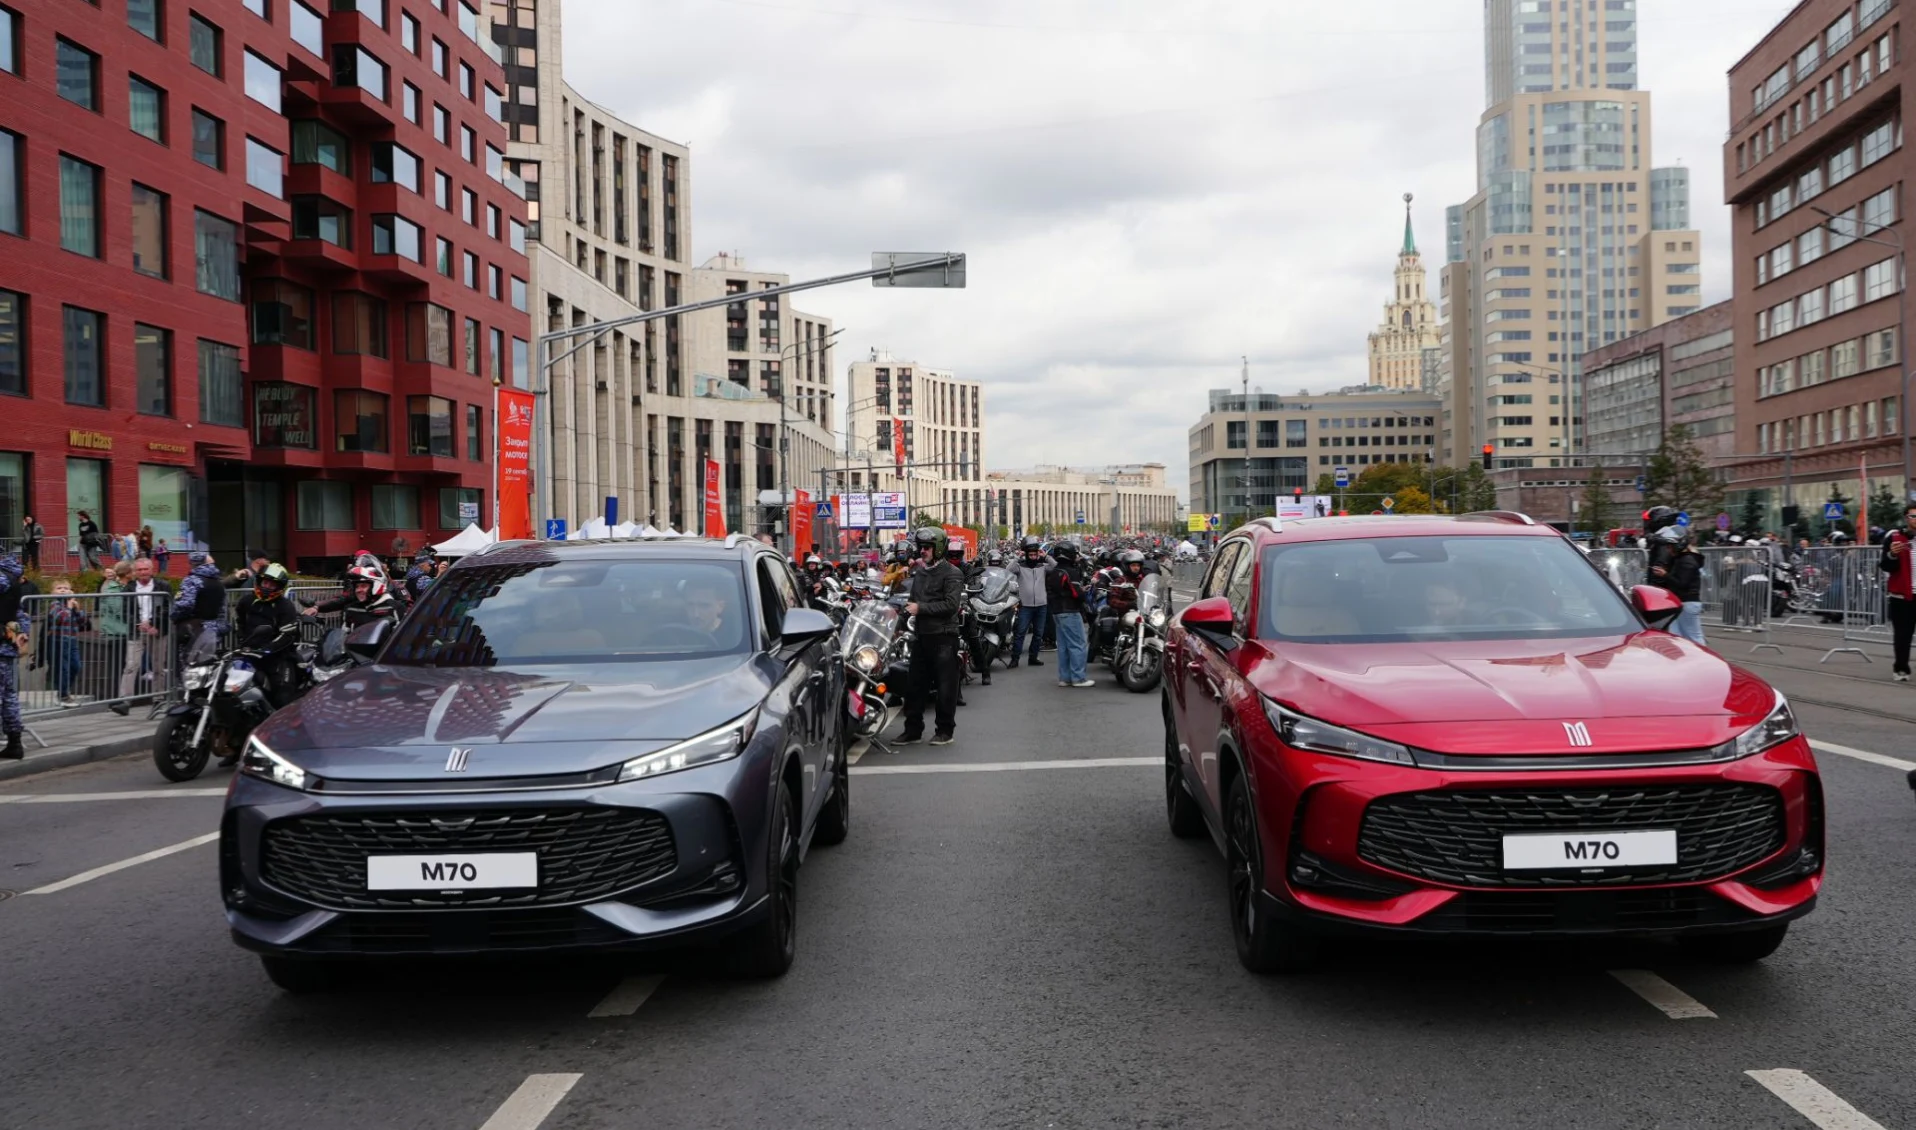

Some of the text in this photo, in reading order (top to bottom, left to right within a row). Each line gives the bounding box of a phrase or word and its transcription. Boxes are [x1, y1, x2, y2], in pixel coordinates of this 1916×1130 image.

[69, 429, 112, 450] World Class
[1564, 841, 1620, 860] M70
[421, 862, 477, 882] M70
